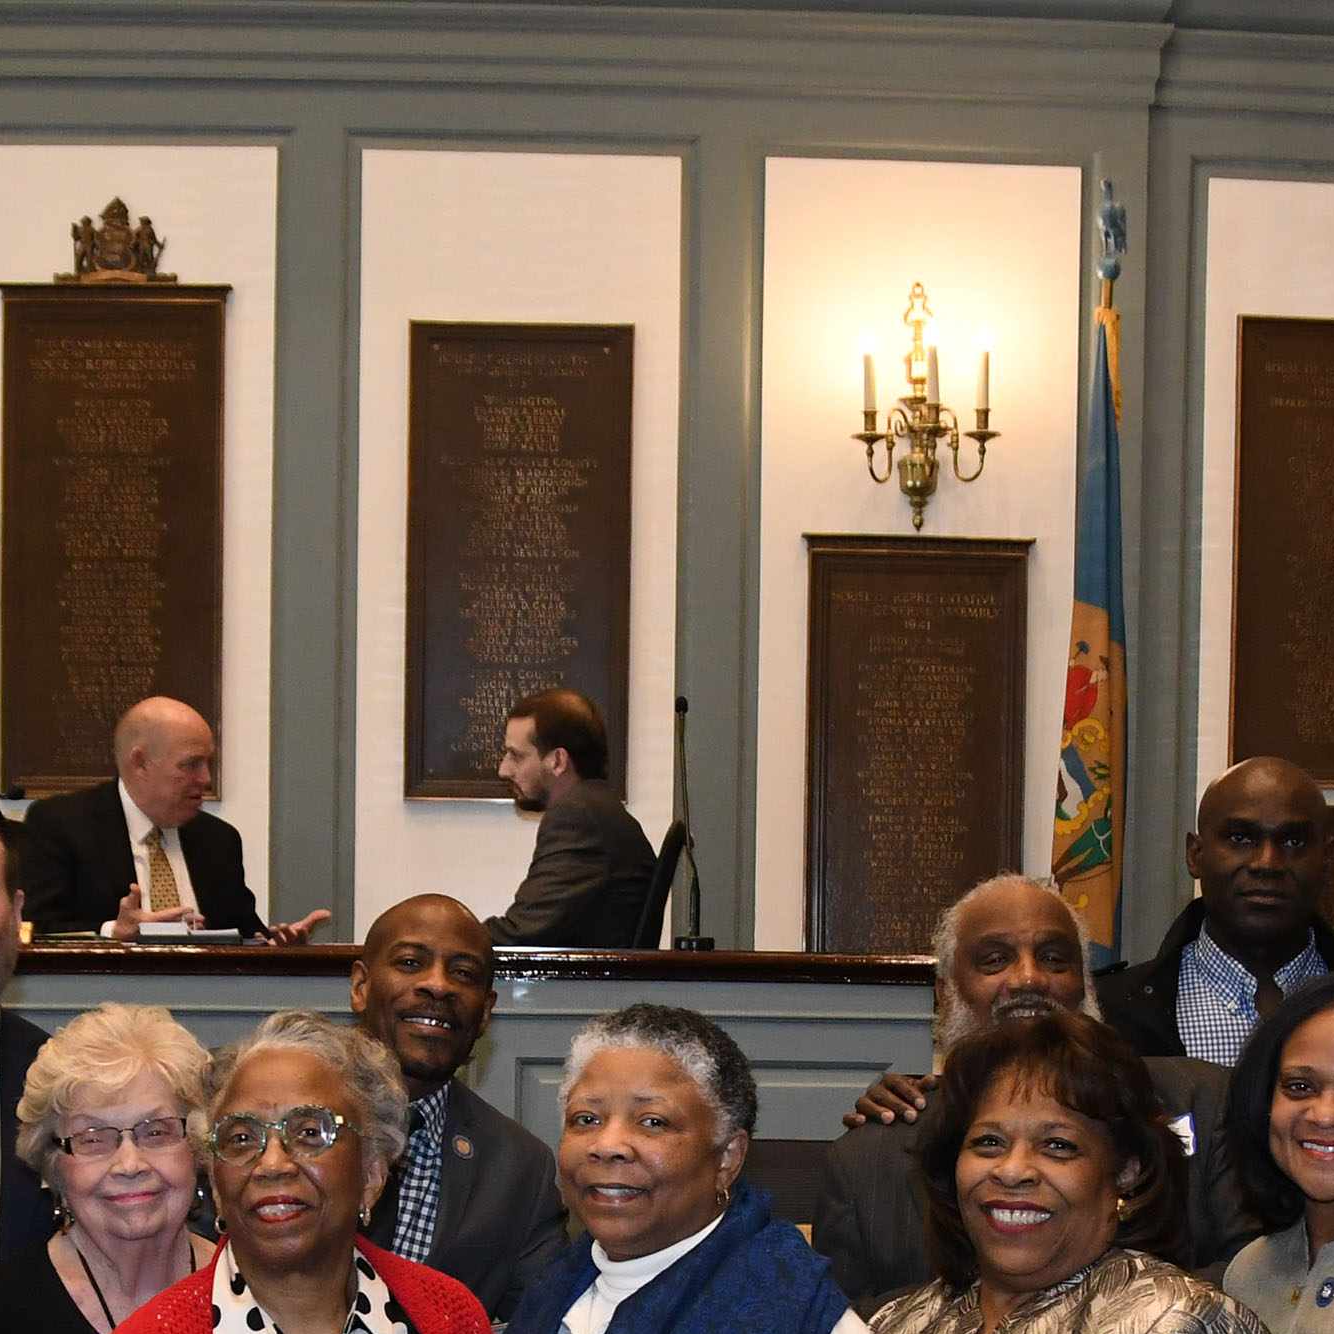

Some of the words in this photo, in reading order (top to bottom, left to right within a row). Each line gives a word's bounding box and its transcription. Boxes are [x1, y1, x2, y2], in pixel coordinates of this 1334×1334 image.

[528, 521, 566, 531] LETER
[513, 549, 580, 559] DERRICKON
[477, 592, 513, 601] OSEPH
[893, 592, 999, 606] REPREENTATIVE
[468, 637, 509, 646] AROLD
[475, 680, 512, 689] LUCIU
